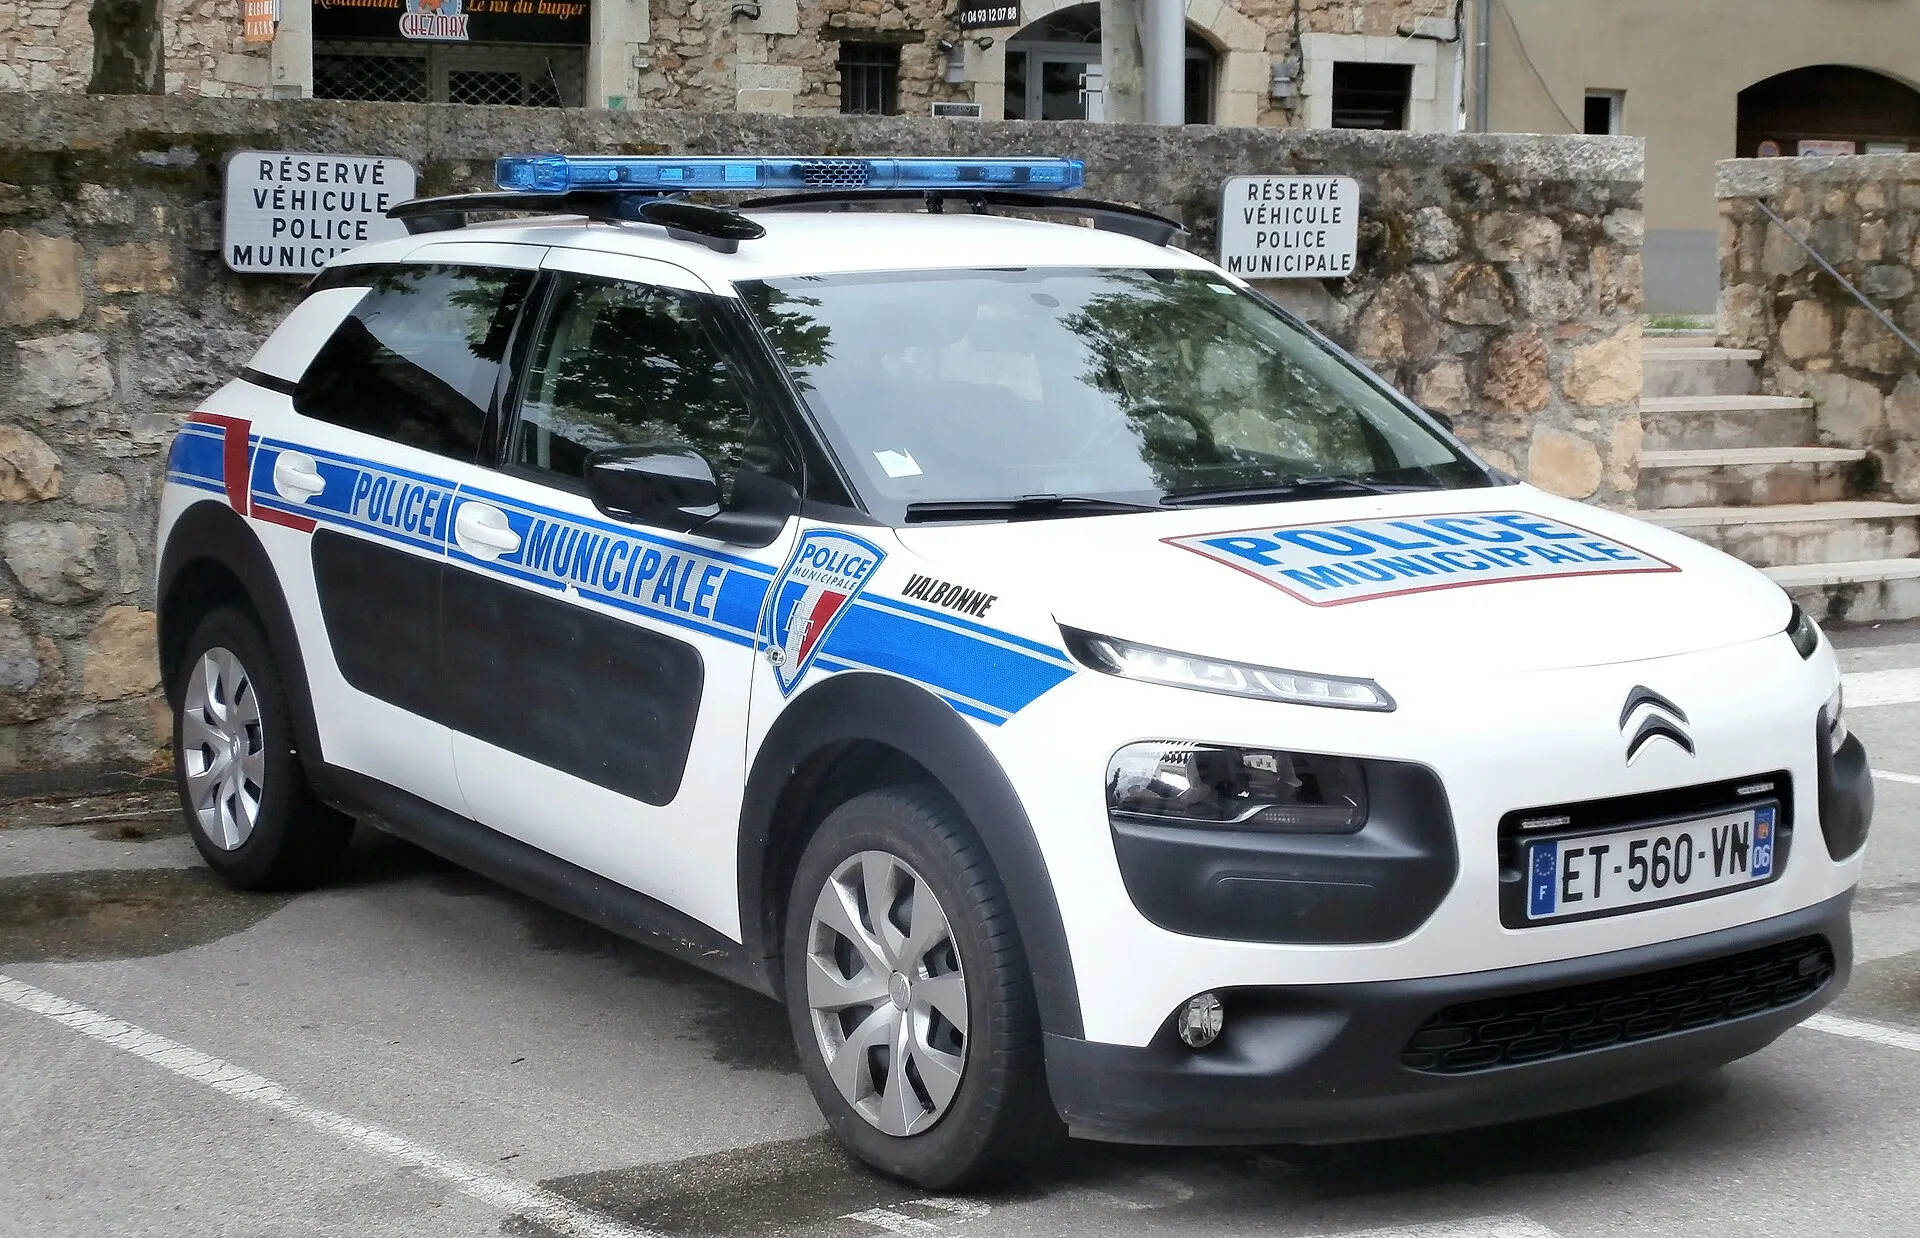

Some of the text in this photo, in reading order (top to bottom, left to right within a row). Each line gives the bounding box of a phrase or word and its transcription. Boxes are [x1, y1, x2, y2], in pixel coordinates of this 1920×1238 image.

[968, 7, 1016, 23] 04 93 12 07 88
[259, 156, 385, 185] RÉSERVÉ
[253, 185, 390, 213] VÉHICULE
[1248, 179, 1340, 201] RÉSERVÉ
[1243, 203, 1342, 225] VÉHICULE
[272, 217, 368, 241] POLICE
[1256, 230, 1326, 249] POLICE
[1227, 253, 1351, 273] MUNICIPALE
[352, 471, 725, 620] POLICE MUNICIPALE
[1198, 513, 1588, 567] POLICE
[798, 543, 873, 580] POLICE
[1278, 541, 1642, 591] MUNICIPALE
[791, 566, 858, 591] MUNICIPALE
[901, 573, 999, 619] VALBONNE
[1561, 820, 1750, 904] ET-560-VN
[1753, 844, 1771, 869] 06
[1539, 885, 1548, 901] F
